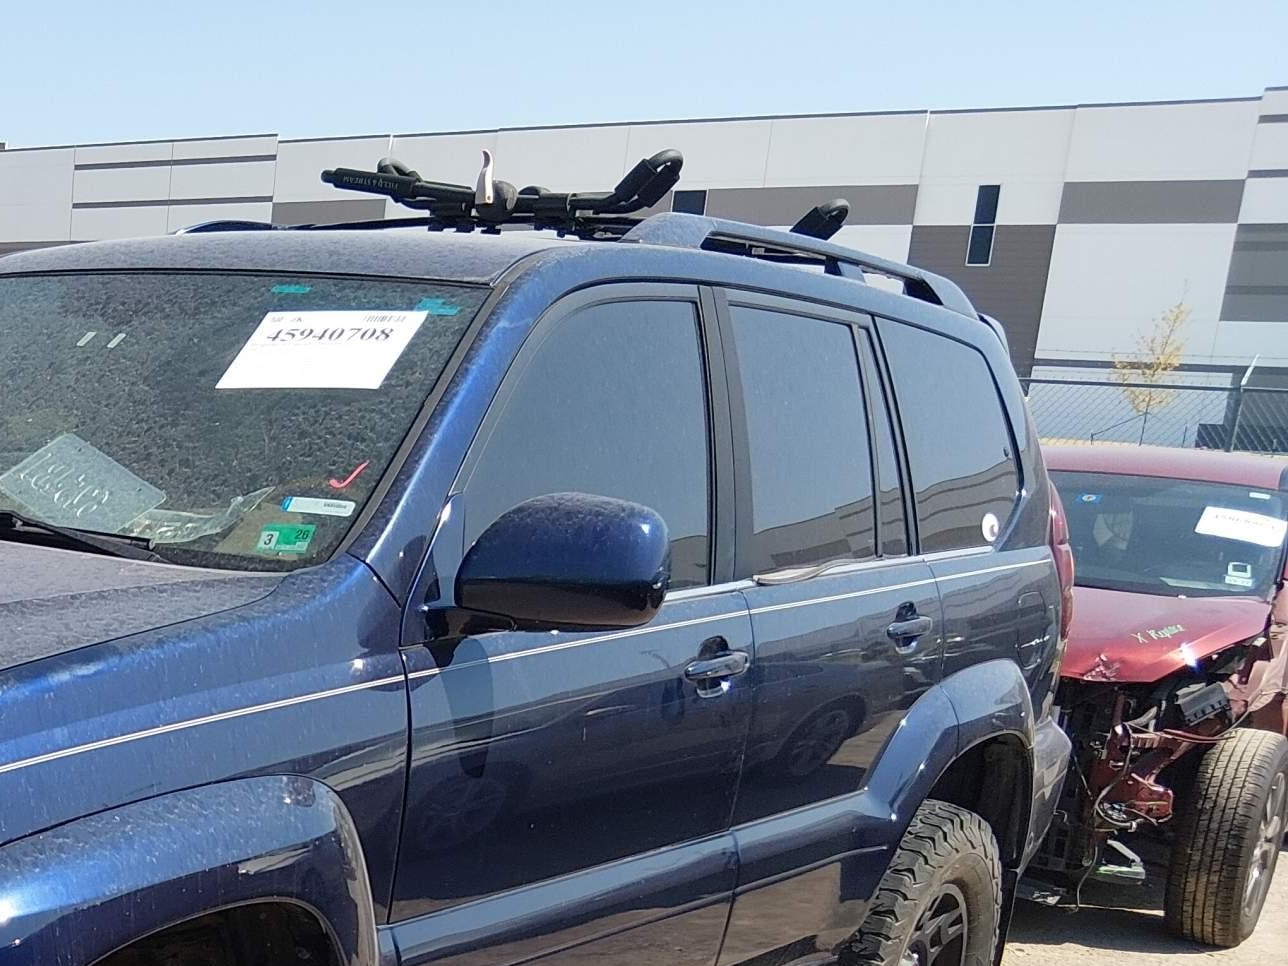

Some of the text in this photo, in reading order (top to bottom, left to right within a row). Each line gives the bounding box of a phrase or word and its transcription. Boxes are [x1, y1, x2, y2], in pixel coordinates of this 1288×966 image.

[266, 327, 395, 342] 45940708
[264, 529, 310, 545] 3 26
